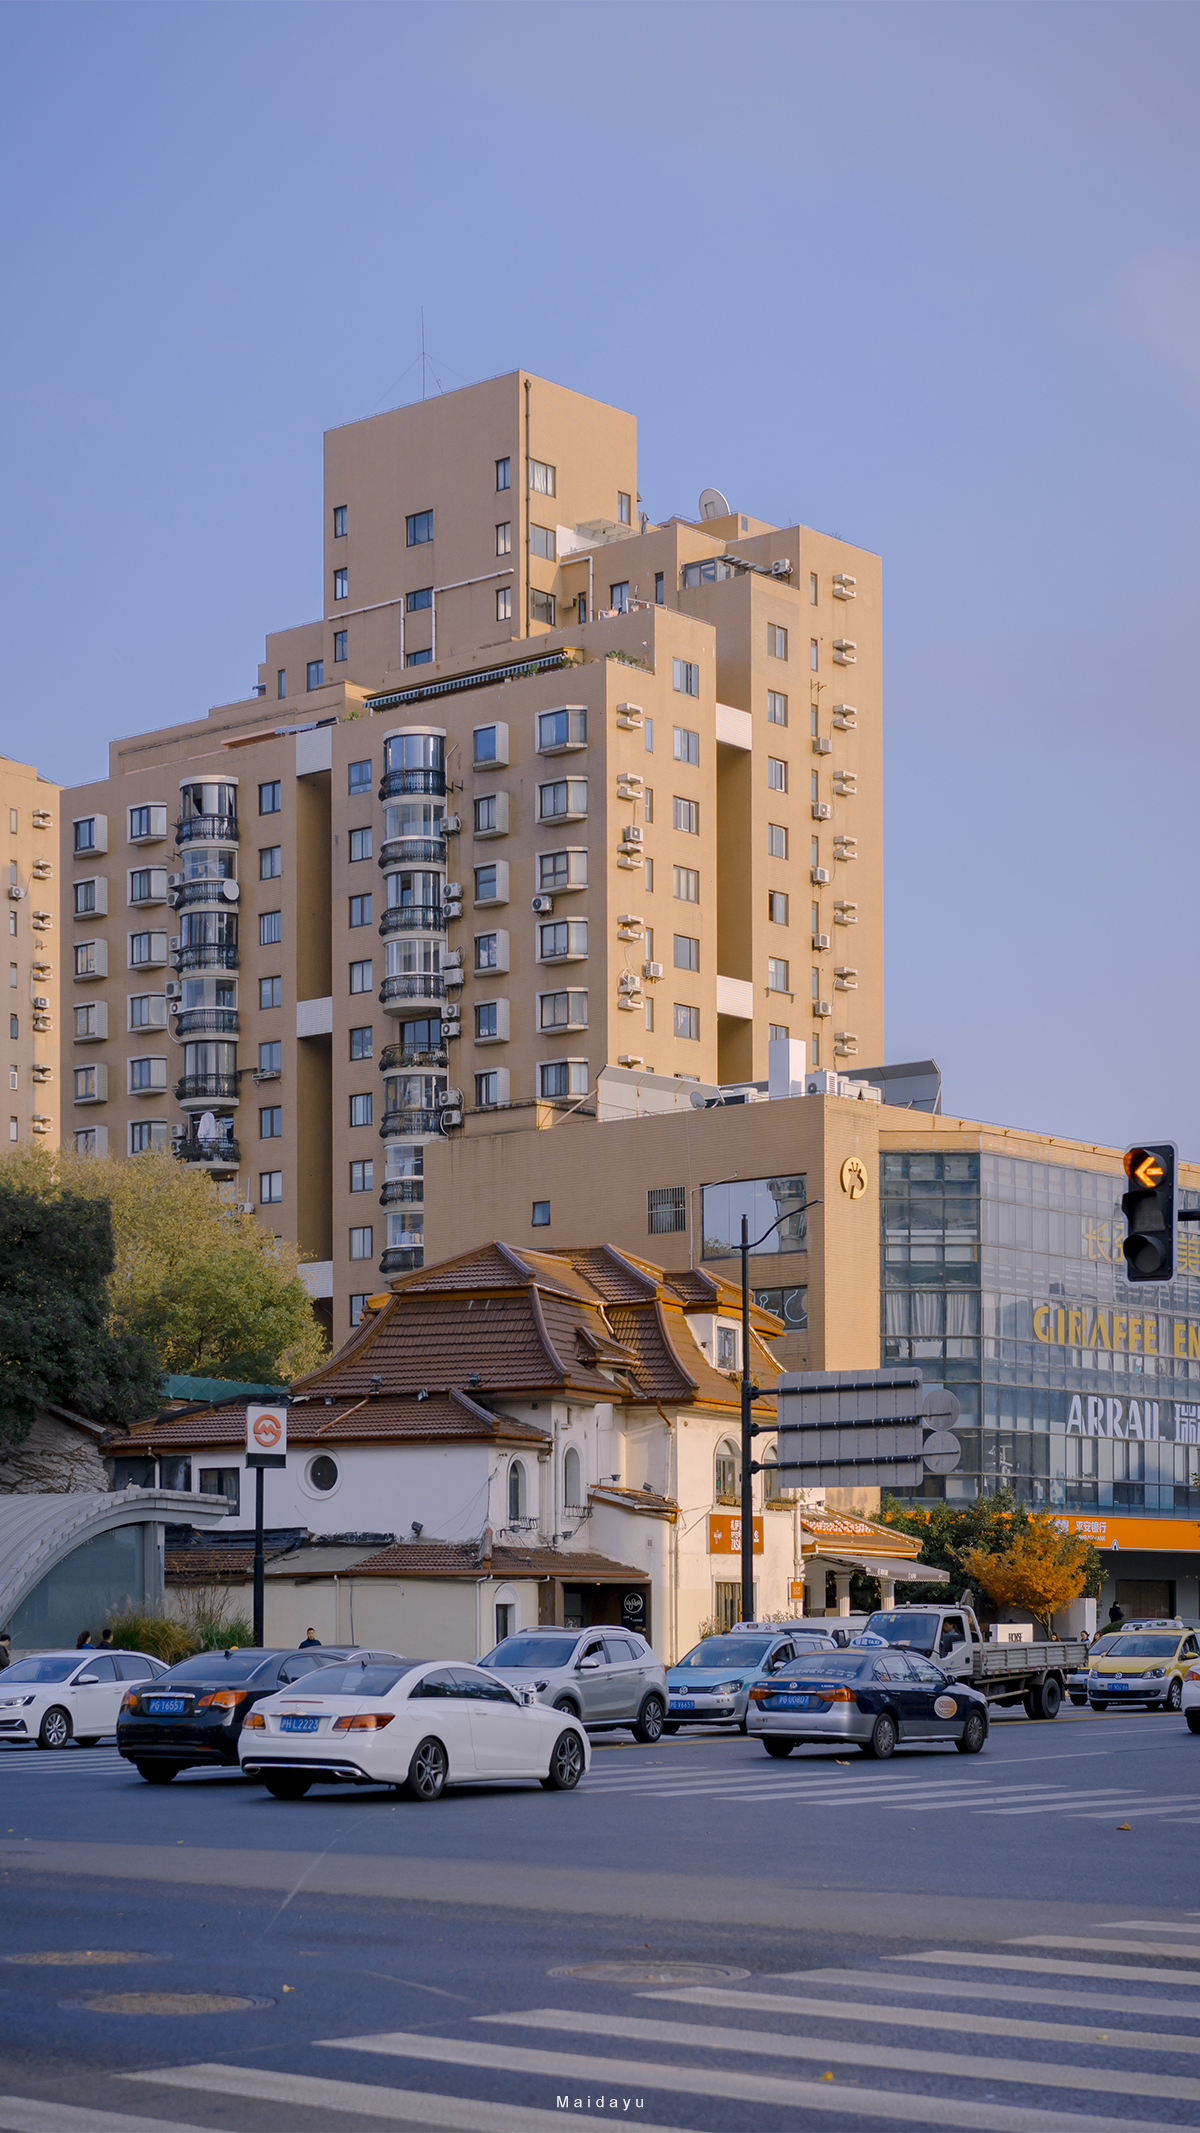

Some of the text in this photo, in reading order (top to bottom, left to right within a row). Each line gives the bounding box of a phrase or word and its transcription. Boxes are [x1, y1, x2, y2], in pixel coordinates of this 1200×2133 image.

[1033, 1305, 1158, 1354] GIRAFFE
[1066, 1394, 1167, 1441] ARRAIL
[1076, 1520, 1107, 1533] 平安银行
